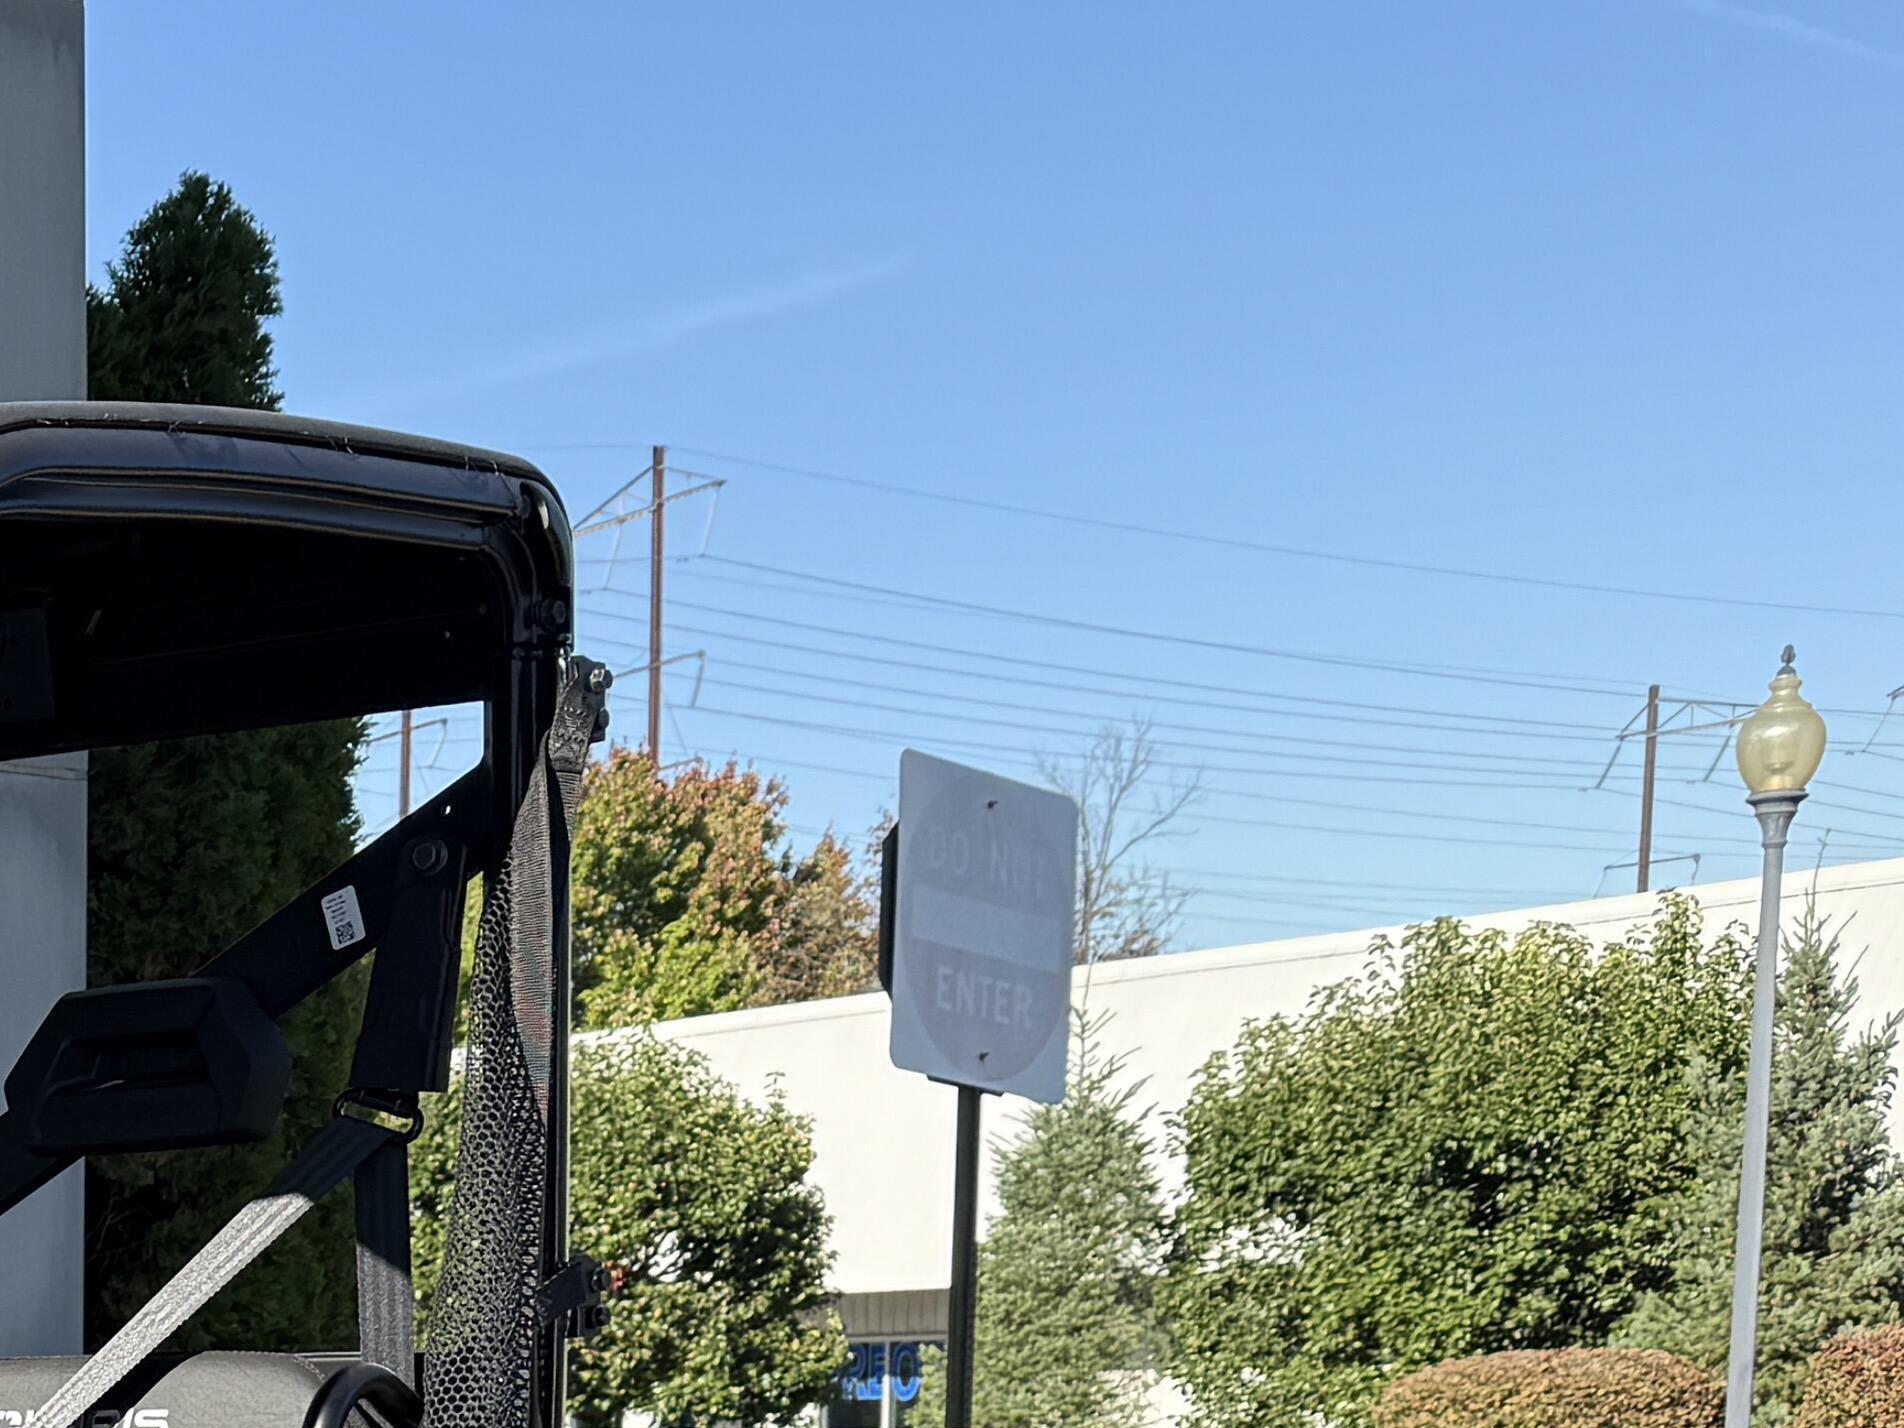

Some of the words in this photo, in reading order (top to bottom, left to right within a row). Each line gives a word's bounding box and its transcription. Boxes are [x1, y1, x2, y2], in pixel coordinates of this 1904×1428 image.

[928, 828, 969, 875] DO
[993, 838, 1051, 898] NOT
[935, 963, 1033, 1031] ENTER
